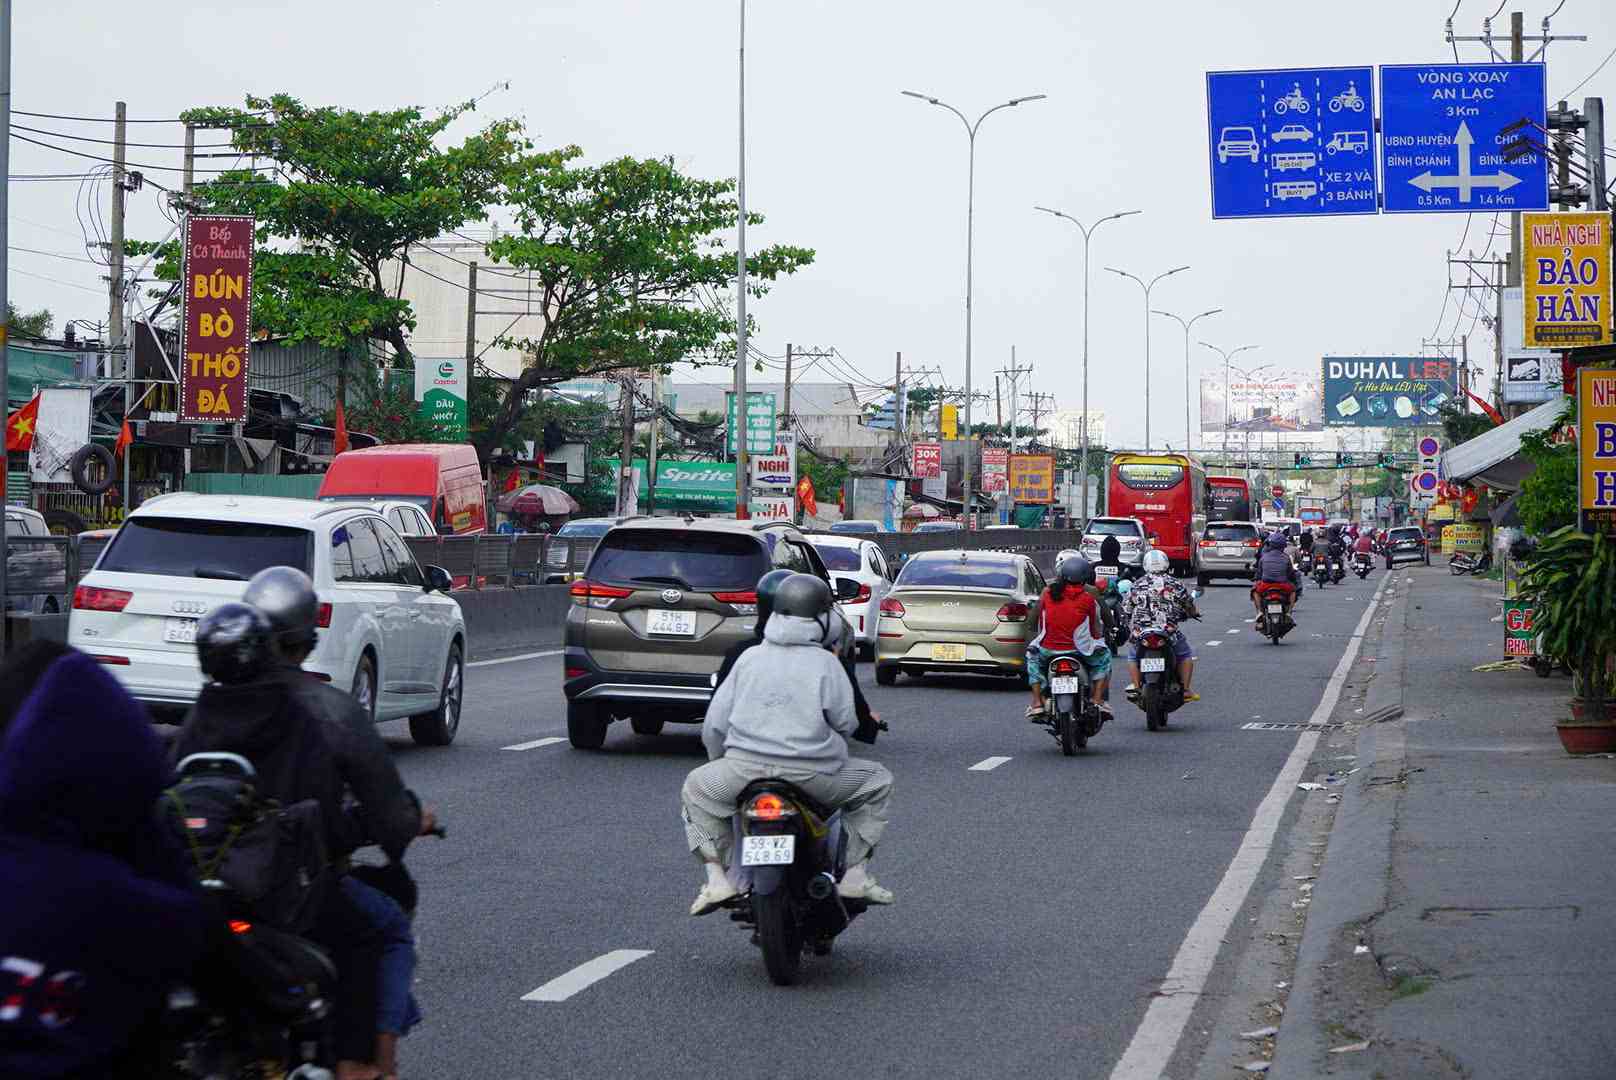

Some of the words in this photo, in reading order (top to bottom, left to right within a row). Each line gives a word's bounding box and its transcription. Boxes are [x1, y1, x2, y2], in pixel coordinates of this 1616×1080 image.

[1418, 69, 1463, 84] VÒNG
[1468, 72, 1510, 84] XOAY
[1432, 89, 1457, 101] AN
[1462, 88, 1495, 103] LẠC
[1446, 106, 1455, 117] 3
[1386, 136, 1414, 147] UBND
[1387, 154, 1413, 167] BÌNH
[1415, 154, 1451, 166] CHÁNH
[1326, 172, 1345, 183] XE
[1346, 172, 1354, 182] 2
[1355, 168, 1373, 181] VÀ
[1326, 191, 1334, 201] 3
[1336, 188, 1374, 201] BÁNH
[1435, 195, 1451, 205] Km
[1496, 194, 1514, 204] Km
[209, 224, 232, 246] Bếp
[1533, 221, 1563, 247] NHÀ
[1566, 219, 1602, 246] NGHỈ
[193, 245, 209, 259] Cô
[211, 244, 247, 259] Thanh
[1536, 248, 1599, 286] BẢO
[194, 269, 244, 299] BÚN
[1535, 288, 1601, 323] HÂN
[199, 308, 235, 338] BÒ
[187, 347, 246, 378] THỐ
[1329, 362, 1404, 379] DUHAL
[198, 384, 231, 415] ĐÁ
[661, 468, 734, 482] Sprite
